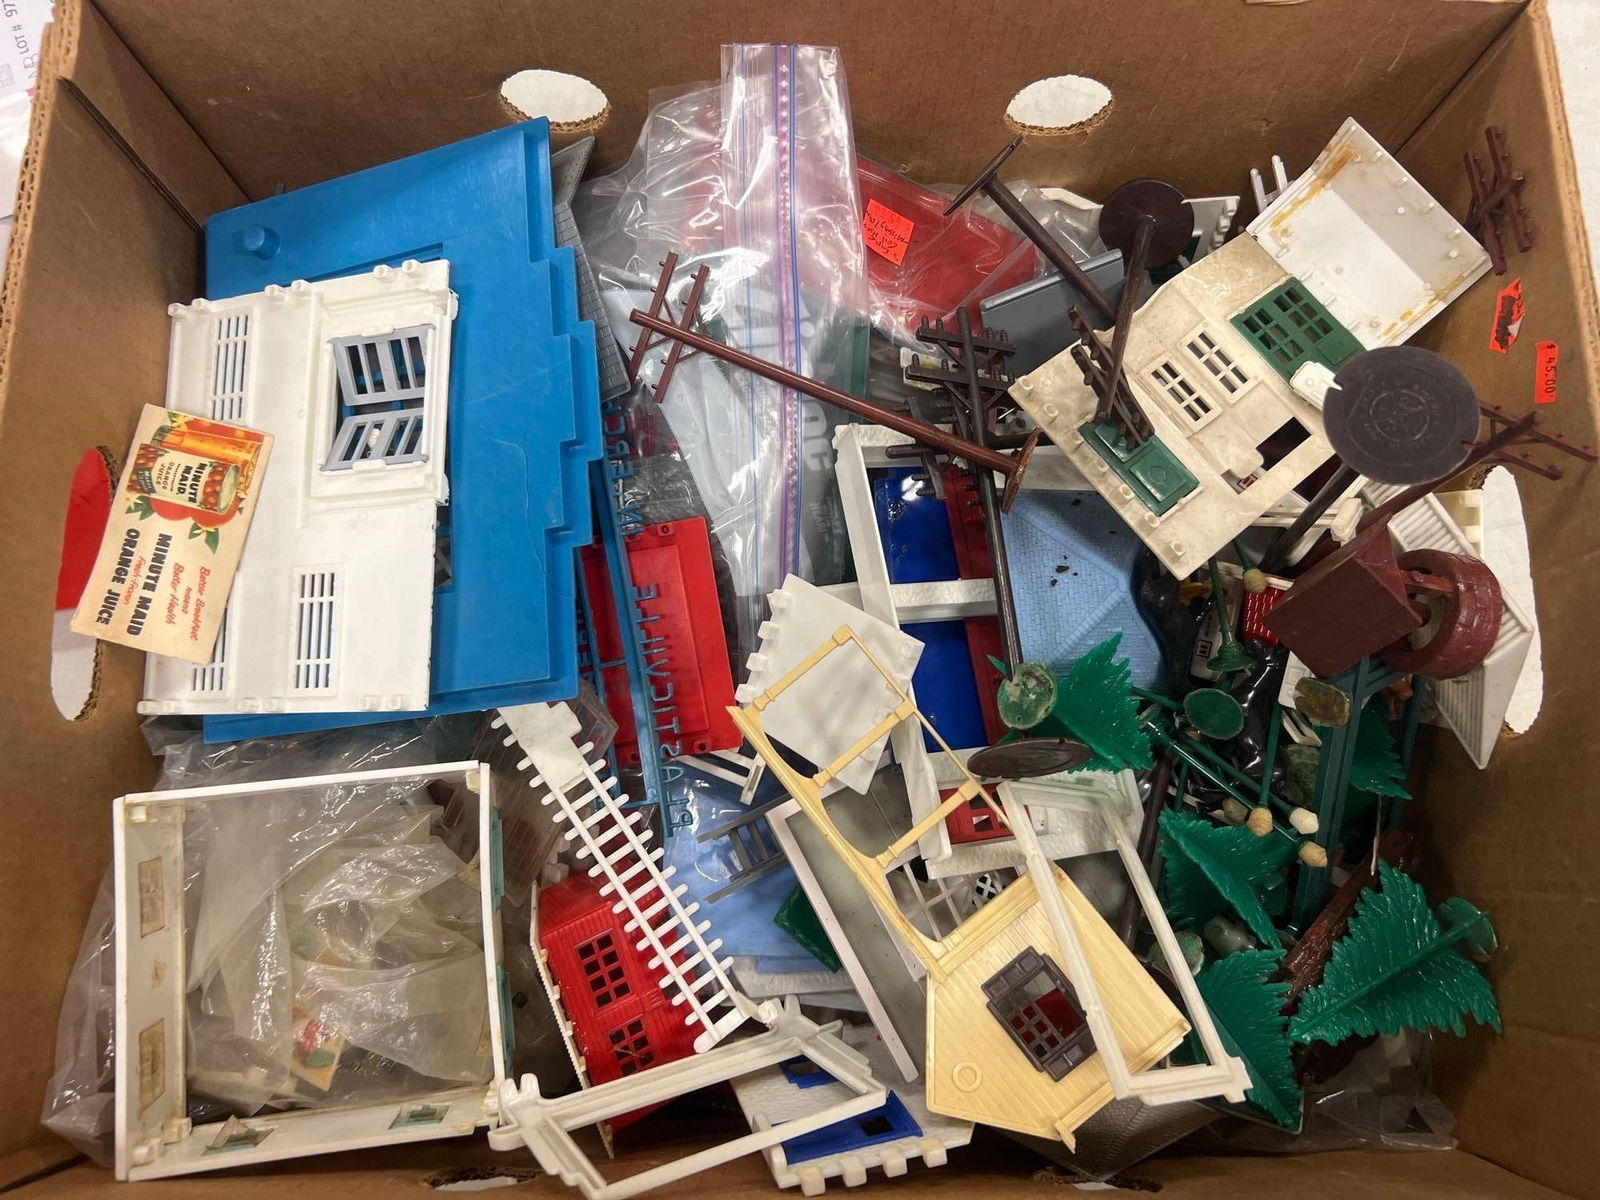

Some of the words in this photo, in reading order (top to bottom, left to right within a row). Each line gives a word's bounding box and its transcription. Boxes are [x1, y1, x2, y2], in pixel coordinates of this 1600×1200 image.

[14, 35, 29, 55] LOT
[155, 463, 166, 485] JUICE
[162, 461, 175, 490] ORANGE
[188, 462, 208, 503] MINUTE
[111, 528, 140, 584] ORANGE
[142, 533, 173, 592] MINUTE
[171, 562, 184, 593] Better
[197, 566, 211, 596] Better
[95, 589, 121, 625] JUICE
[126, 596, 153, 636] MAID
[165, 594, 179, 625] Health
[182, 586, 192, 615] means
[190, 598, 206, 641] Breakfast
